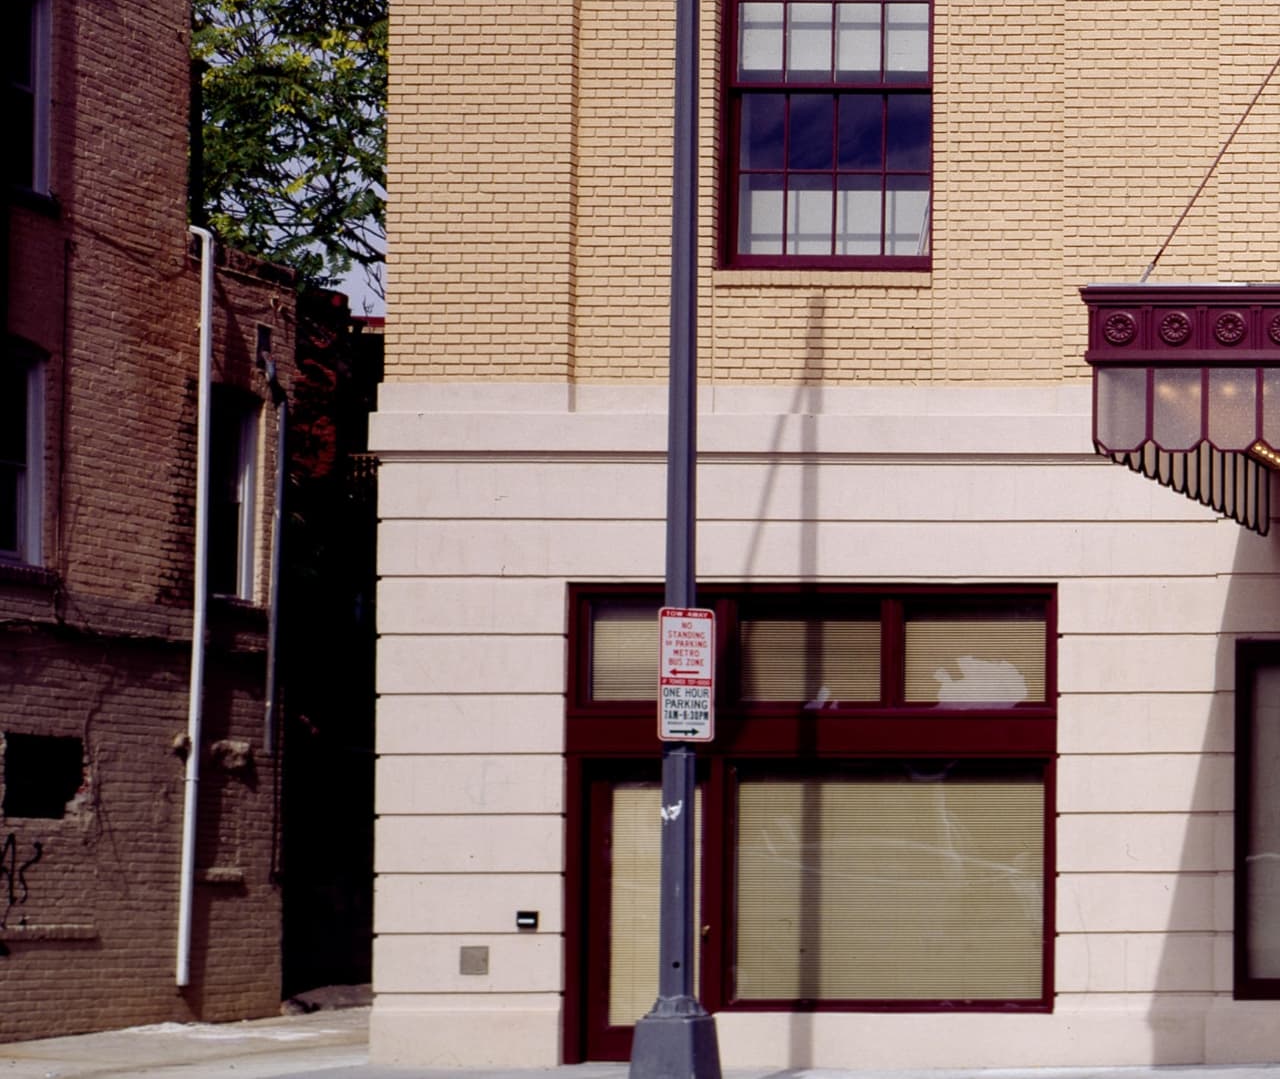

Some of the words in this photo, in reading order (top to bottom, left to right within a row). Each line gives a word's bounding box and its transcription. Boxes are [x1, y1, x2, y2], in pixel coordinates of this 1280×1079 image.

[668, 630, 706, 639] STANDING
[675, 640, 708, 648] PARKING
[673, 649, 700, 657] METRO
[668, 657, 683, 666] BUS
[686, 658, 705, 667] ZONE
[663, 687, 681, 697] ONE
[685, 688, 709, 698] HOUR
[665, 699, 708, 710] PARKING
